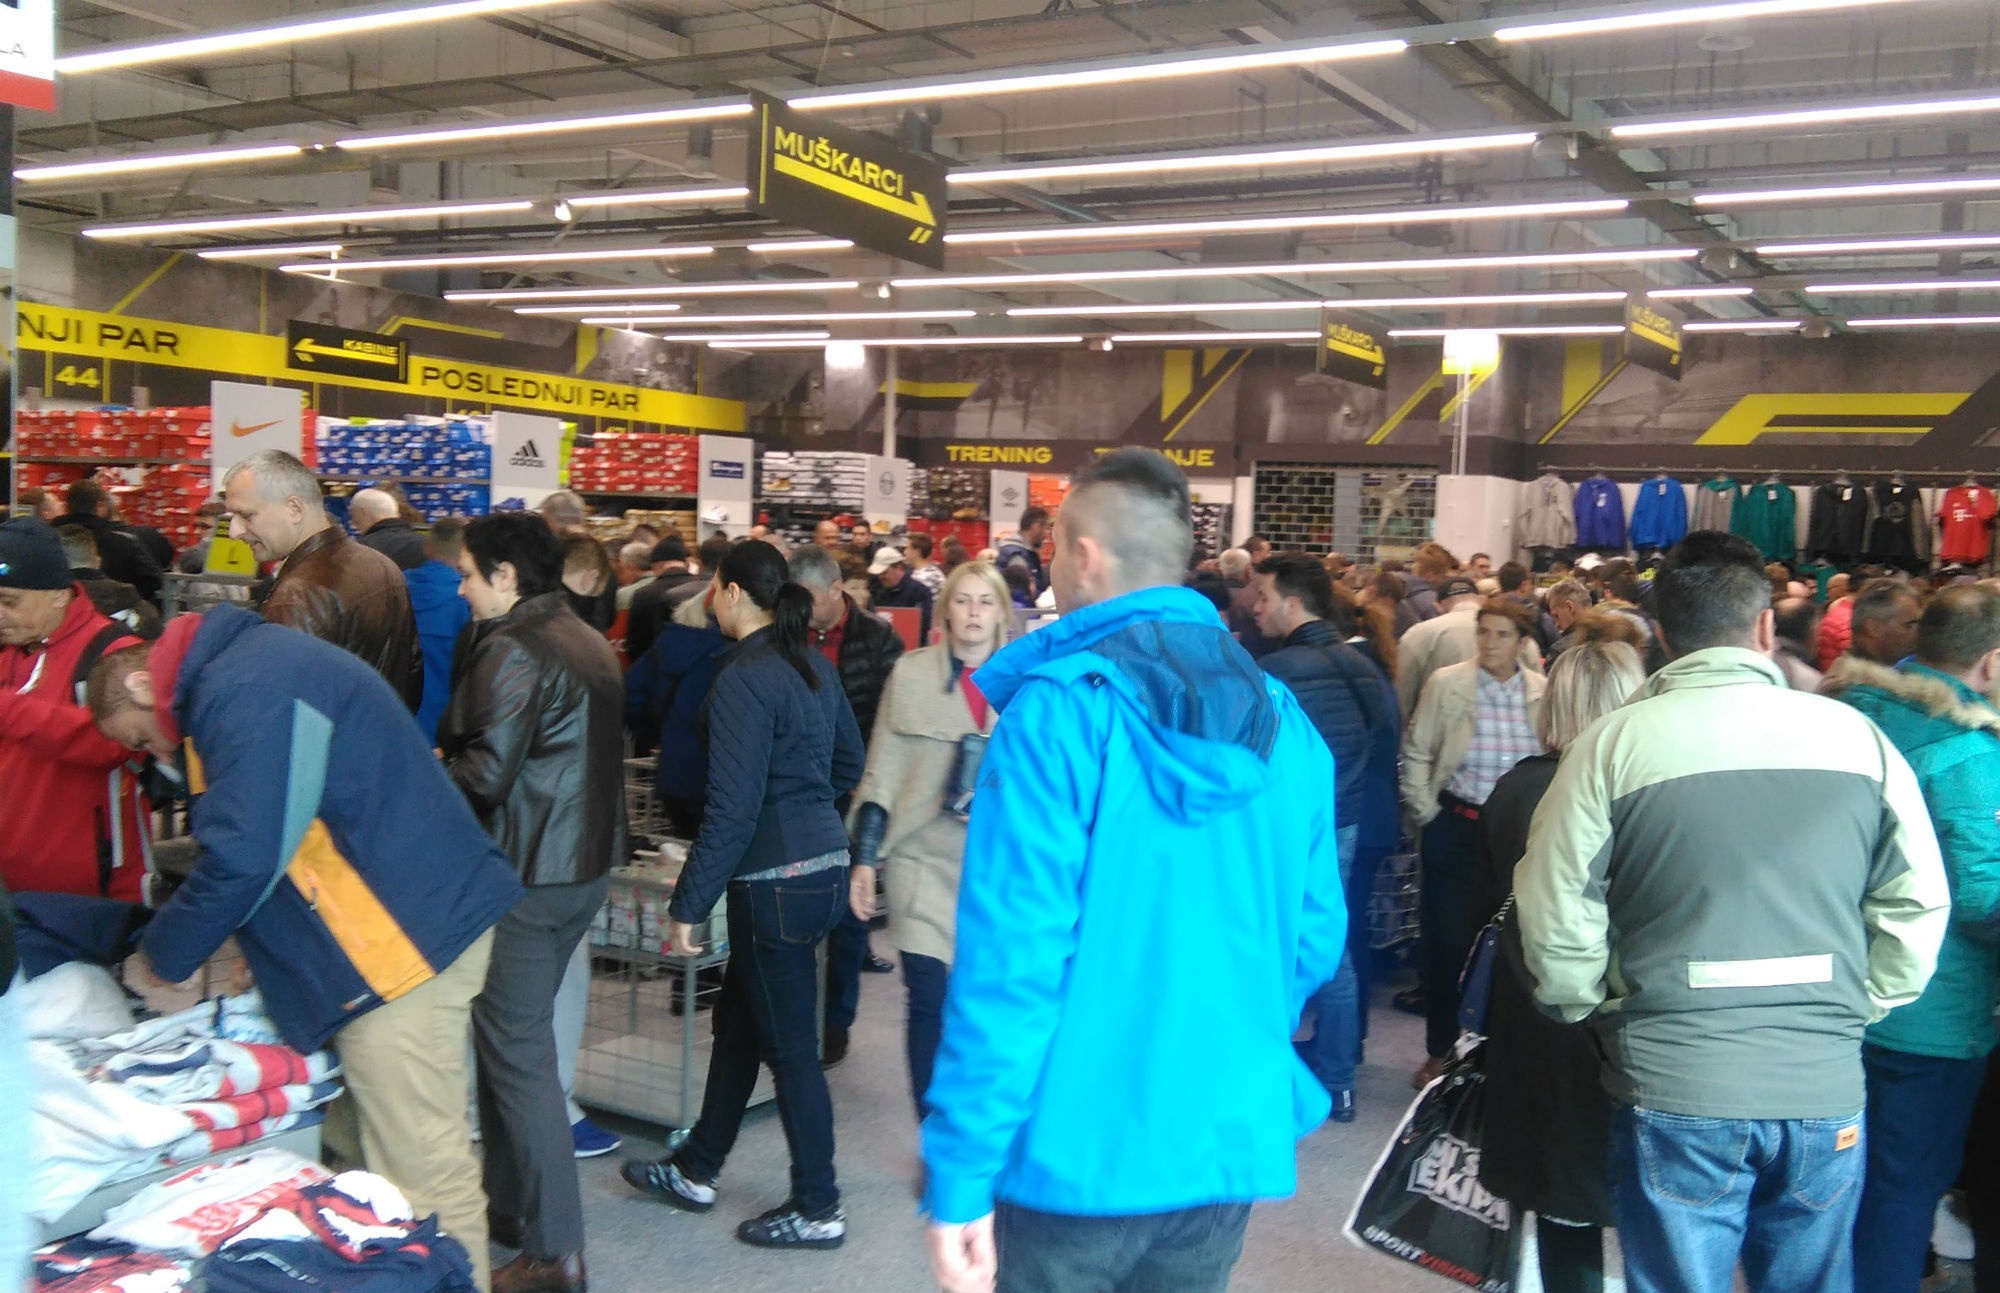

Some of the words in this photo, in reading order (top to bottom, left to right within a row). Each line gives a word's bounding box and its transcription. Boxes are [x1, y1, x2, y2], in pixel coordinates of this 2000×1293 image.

[774, 125, 904, 196] MUŠKARCI
[99, 323, 180, 356] PAR
[55, 365, 100, 389] 44
[421, 366, 582, 405] POSLEDNJI
[590, 389, 640, 412] PAR
[509, 457, 545, 468] adidas
[945, 445, 1053, 464] TRENING
[1414, 1155, 1505, 1223] EKIPA
